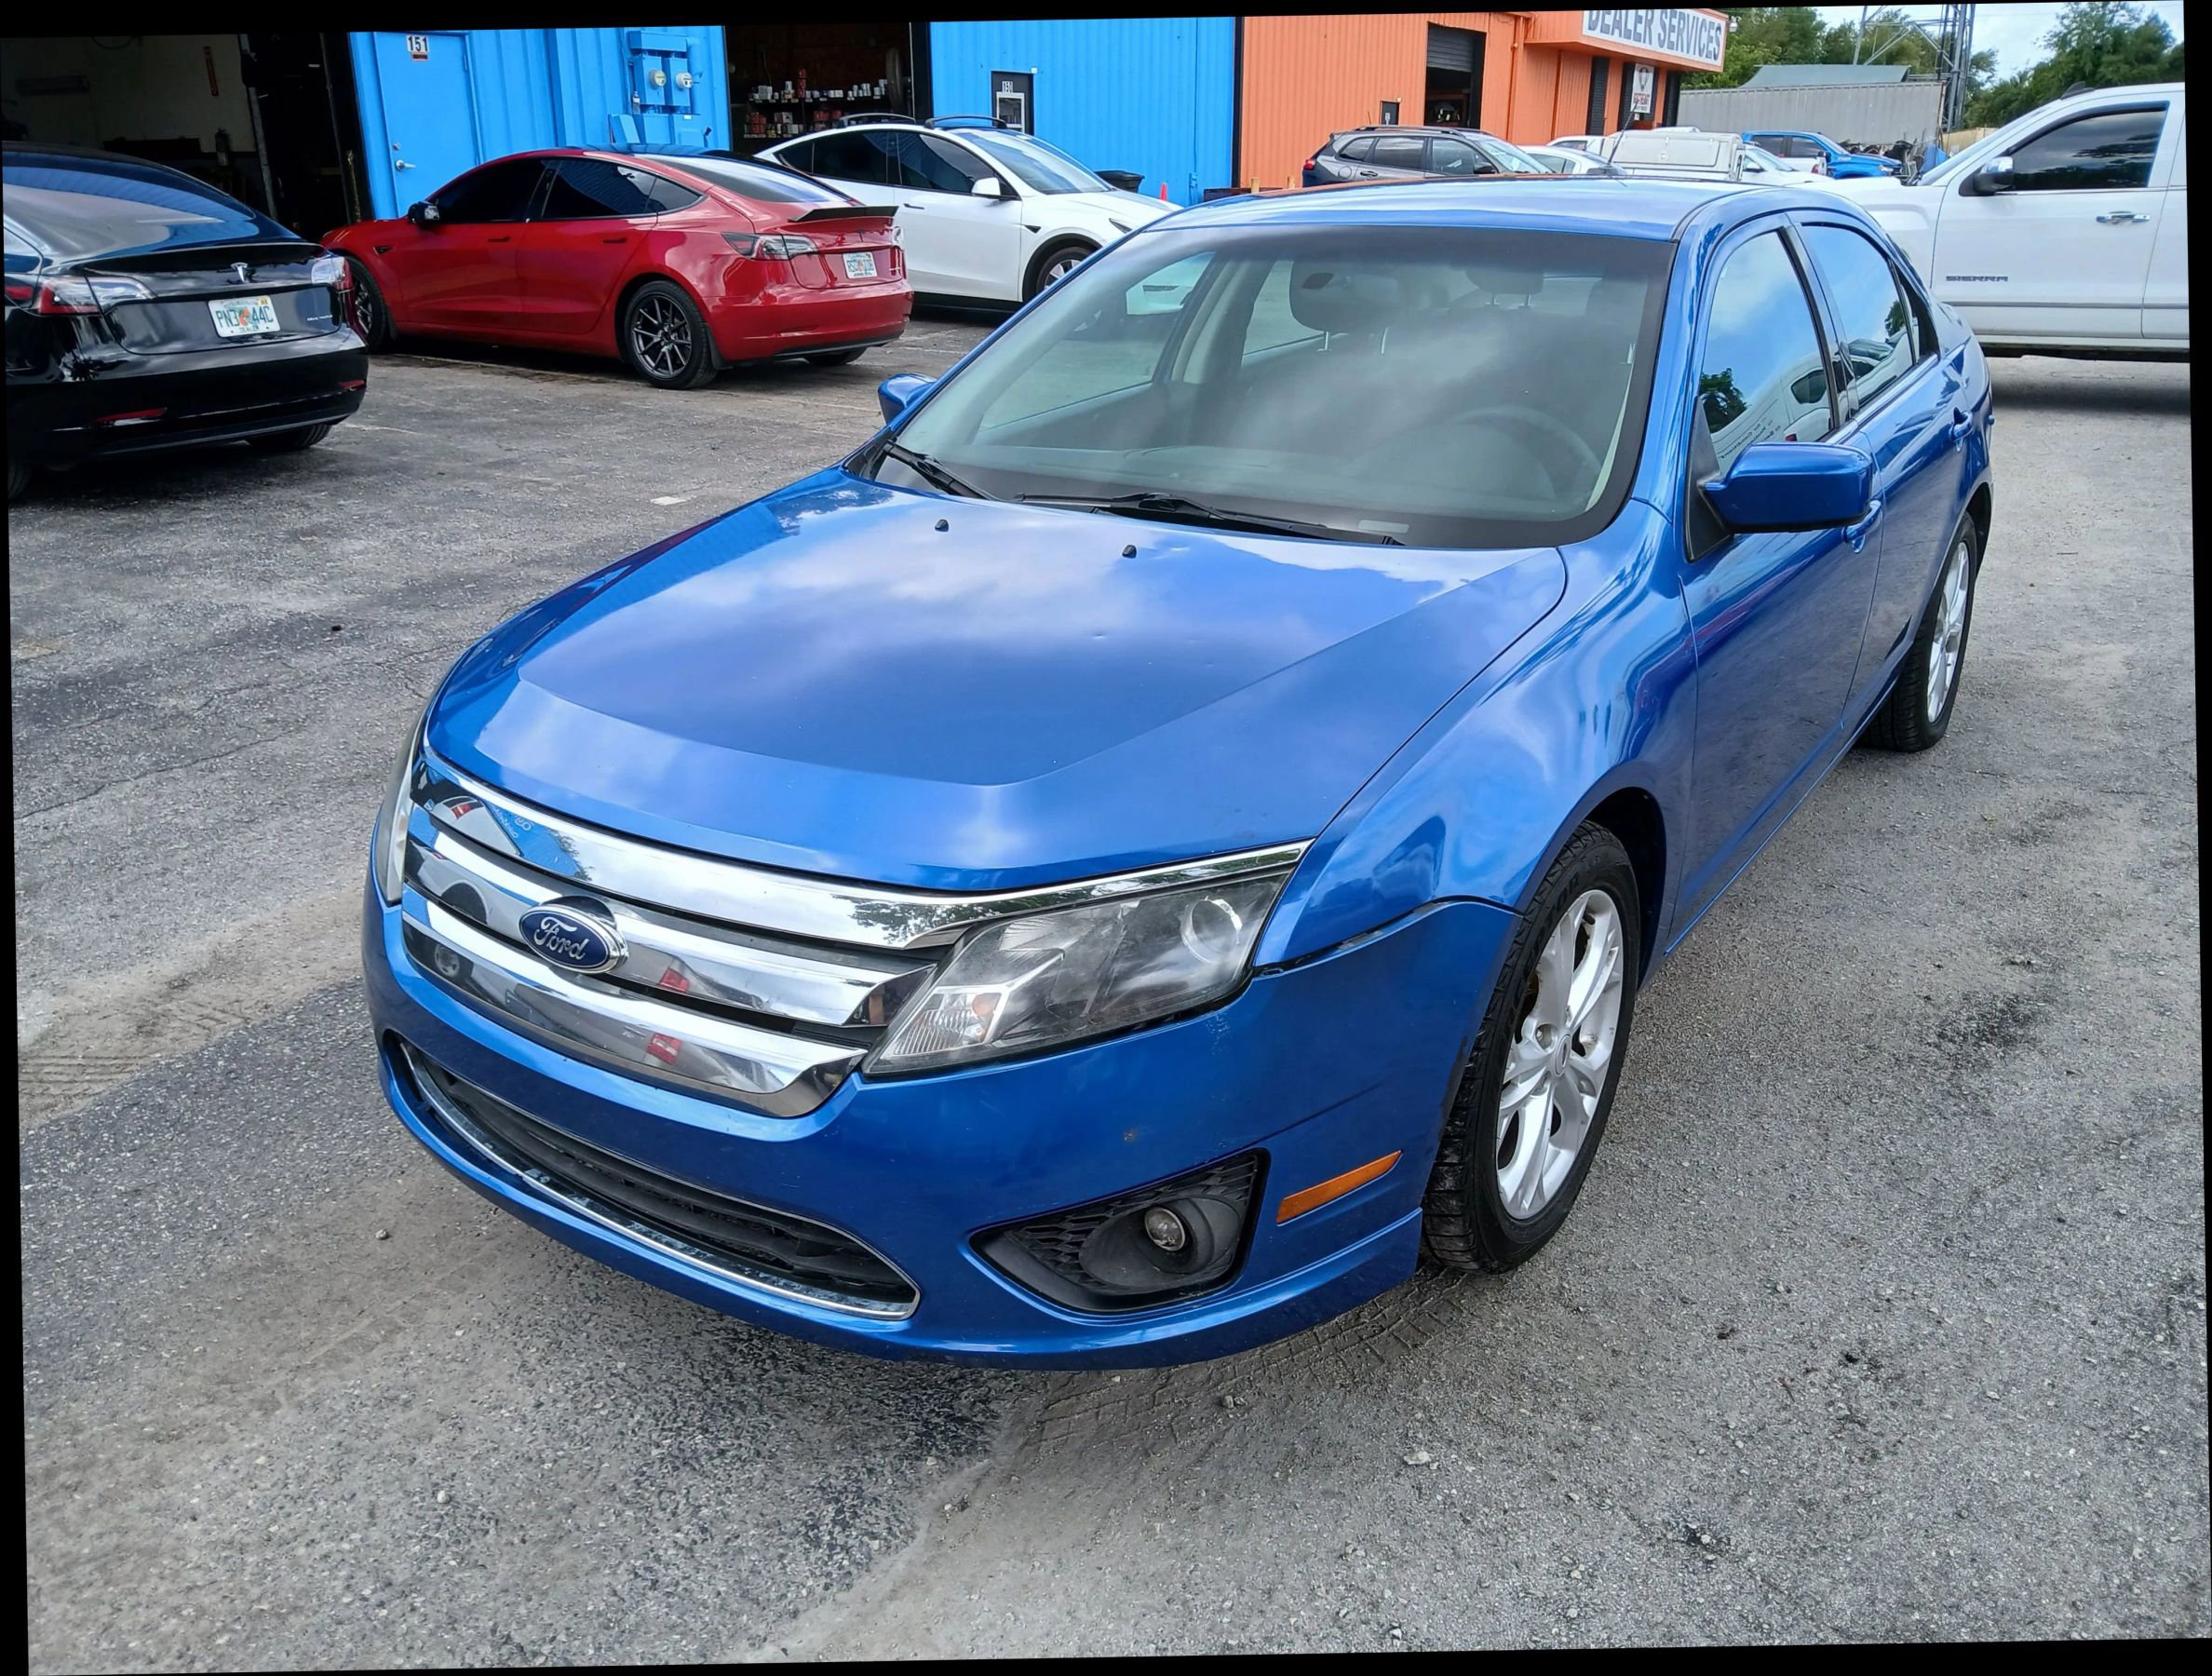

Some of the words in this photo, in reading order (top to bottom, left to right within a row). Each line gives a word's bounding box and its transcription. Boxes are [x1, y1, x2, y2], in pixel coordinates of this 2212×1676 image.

[408, 35, 428, 52] 151
[1658, 9, 1722, 61] SERVICES
[533, 916, 590, 960] Ford
